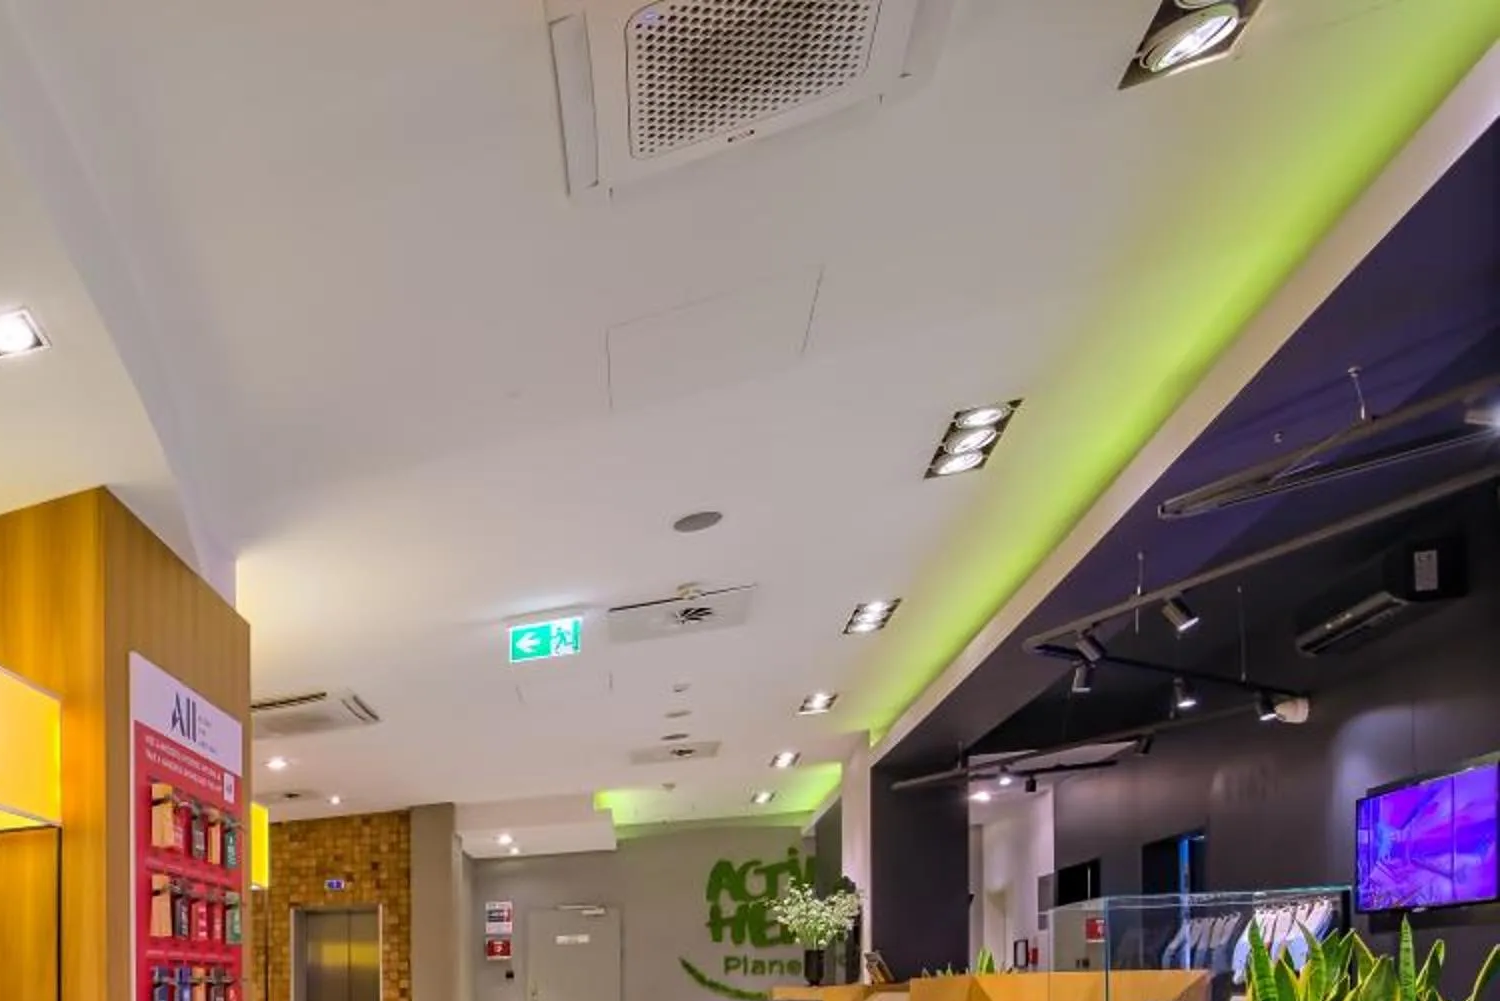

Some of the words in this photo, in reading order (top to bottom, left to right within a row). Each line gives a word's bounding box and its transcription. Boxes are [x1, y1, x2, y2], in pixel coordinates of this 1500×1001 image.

[171, 692, 197, 743] All
[706, 847, 816, 903] ACTi
[723, 953, 802, 976] Plane
